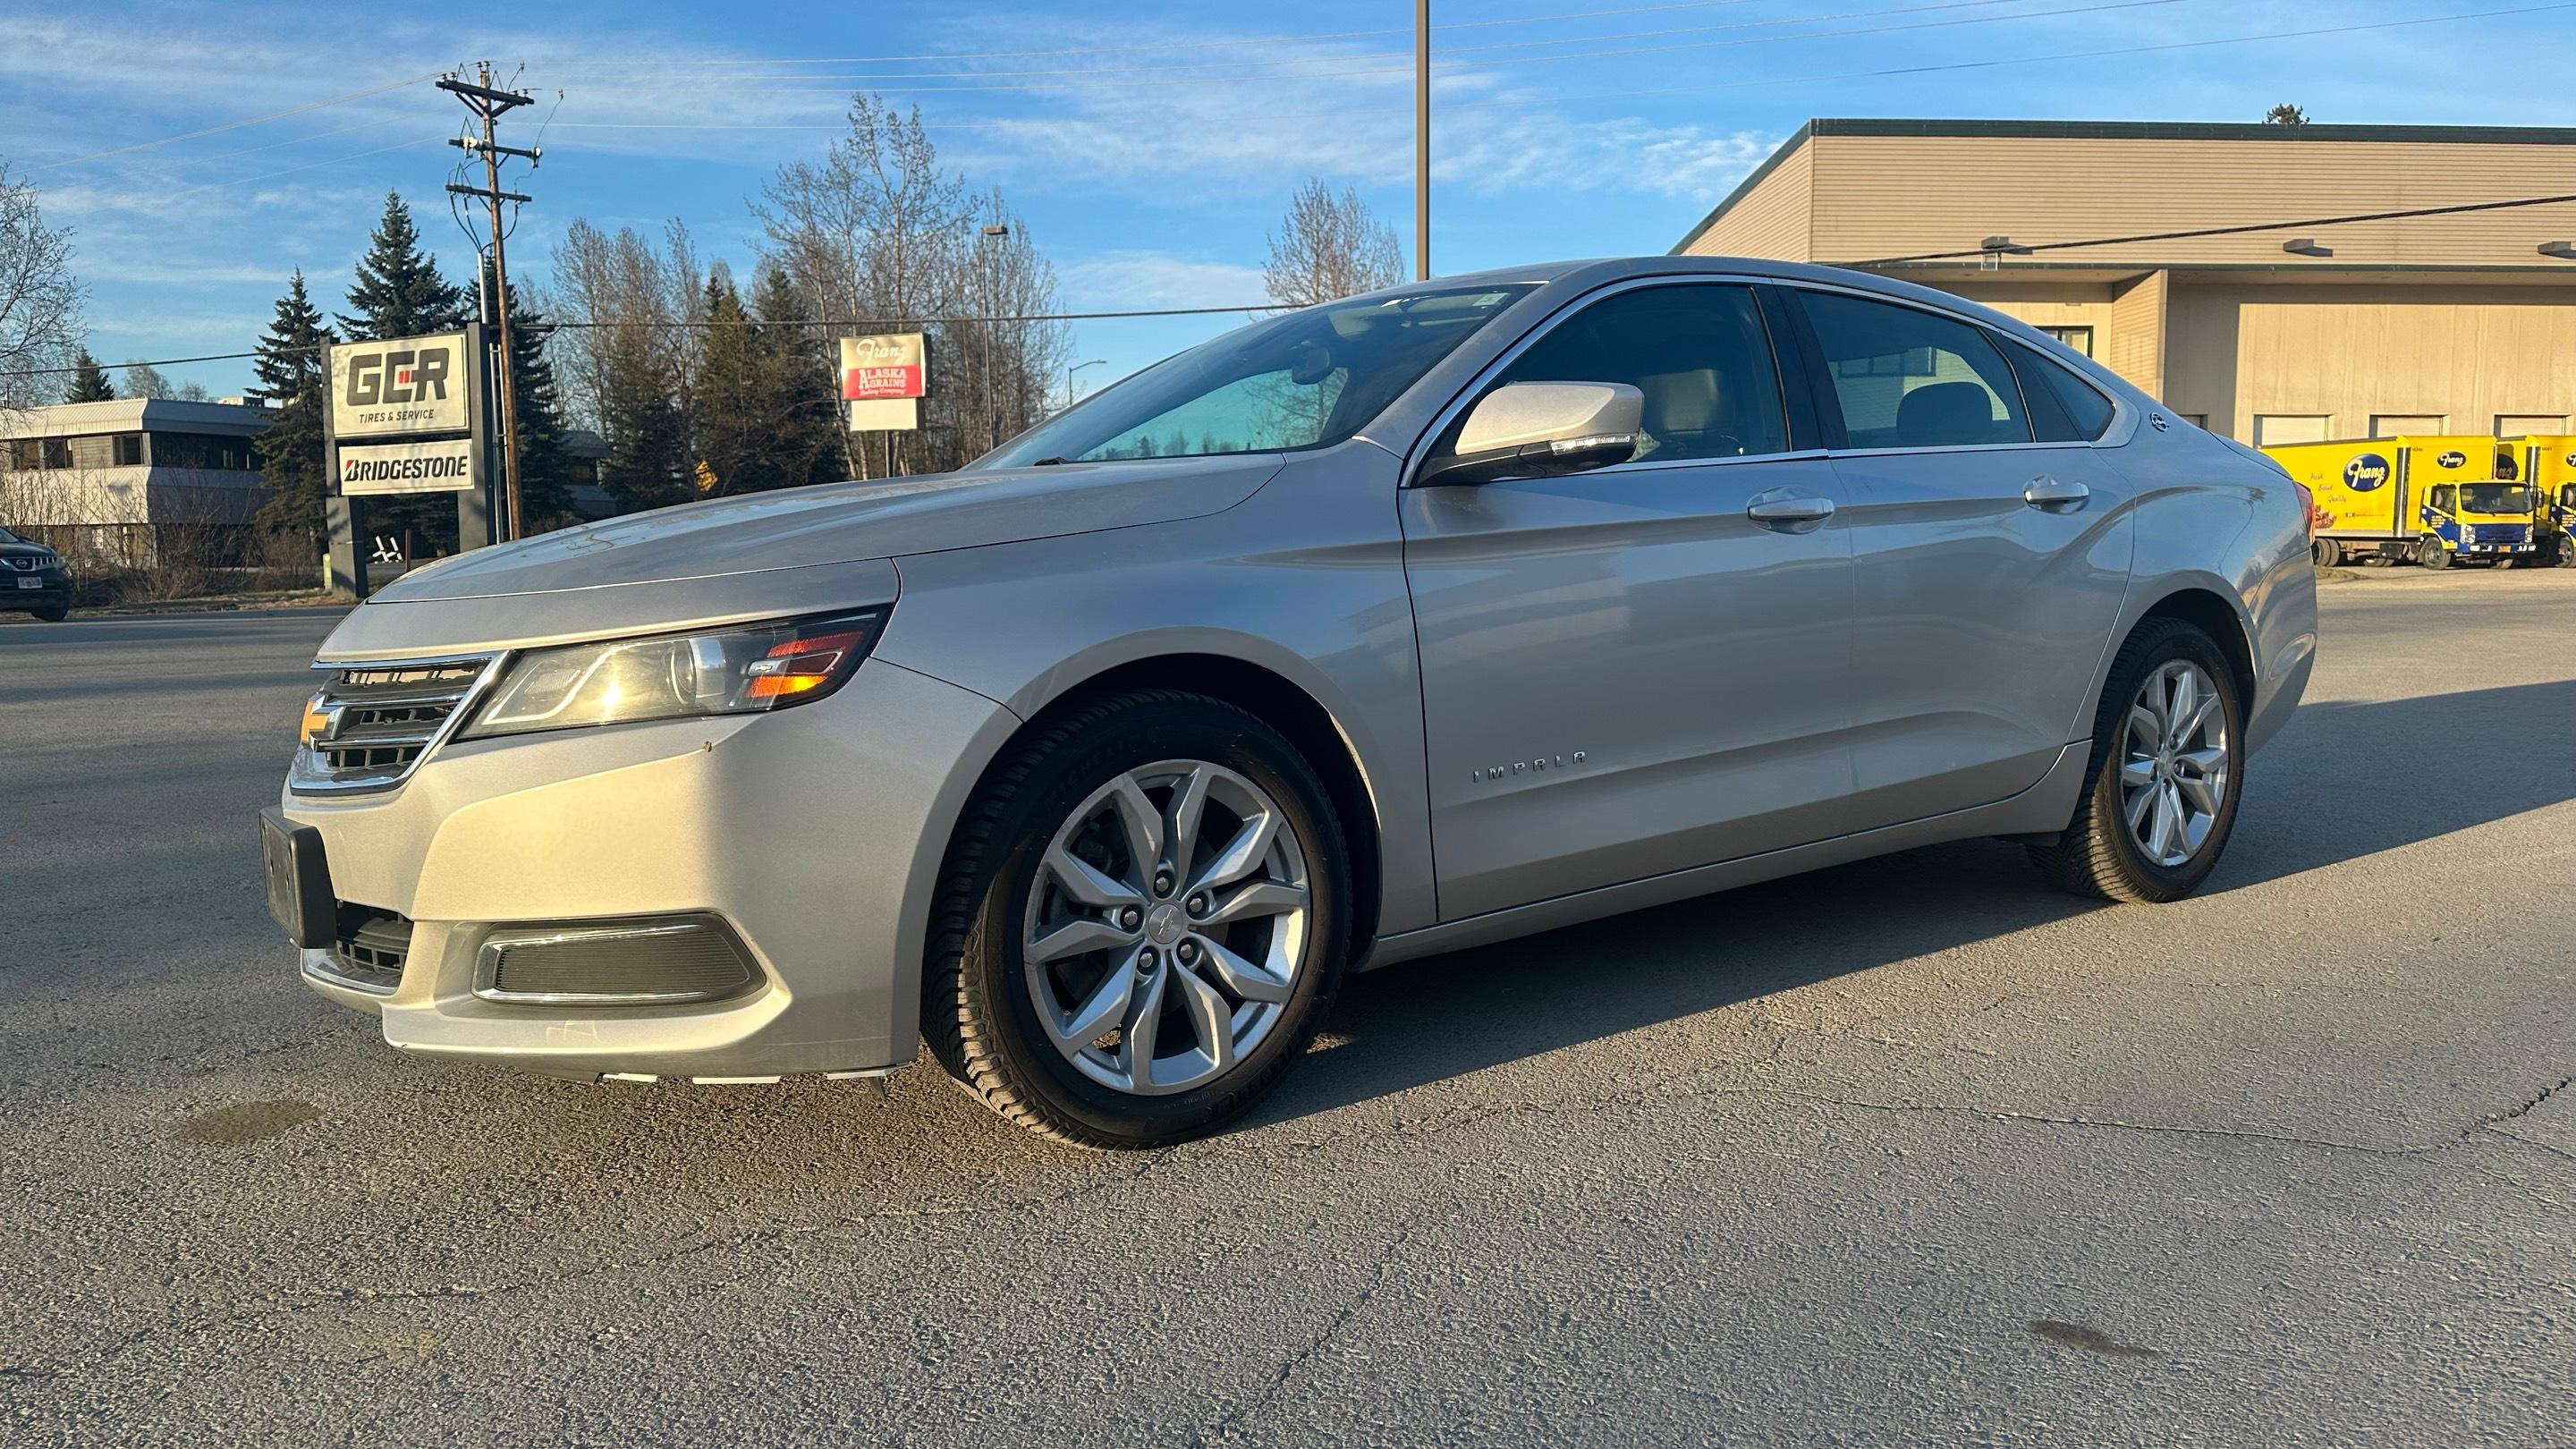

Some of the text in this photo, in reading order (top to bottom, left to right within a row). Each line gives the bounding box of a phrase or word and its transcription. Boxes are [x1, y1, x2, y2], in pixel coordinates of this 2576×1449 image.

[346, 348, 449, 406] GCR
[859, 368, 906, 389] ALASKA
[869, 378, 906, 388] GRAINS
[360, 409, 435, 423] TIRES & SERVICE
[344, 455, 468, 481] BRIDGESTONE
[2440, 453, 2463, 466] Franz
[2348, 459, 2385, 487] Franz
[1473, 750, 1586, 784] IMPALA
